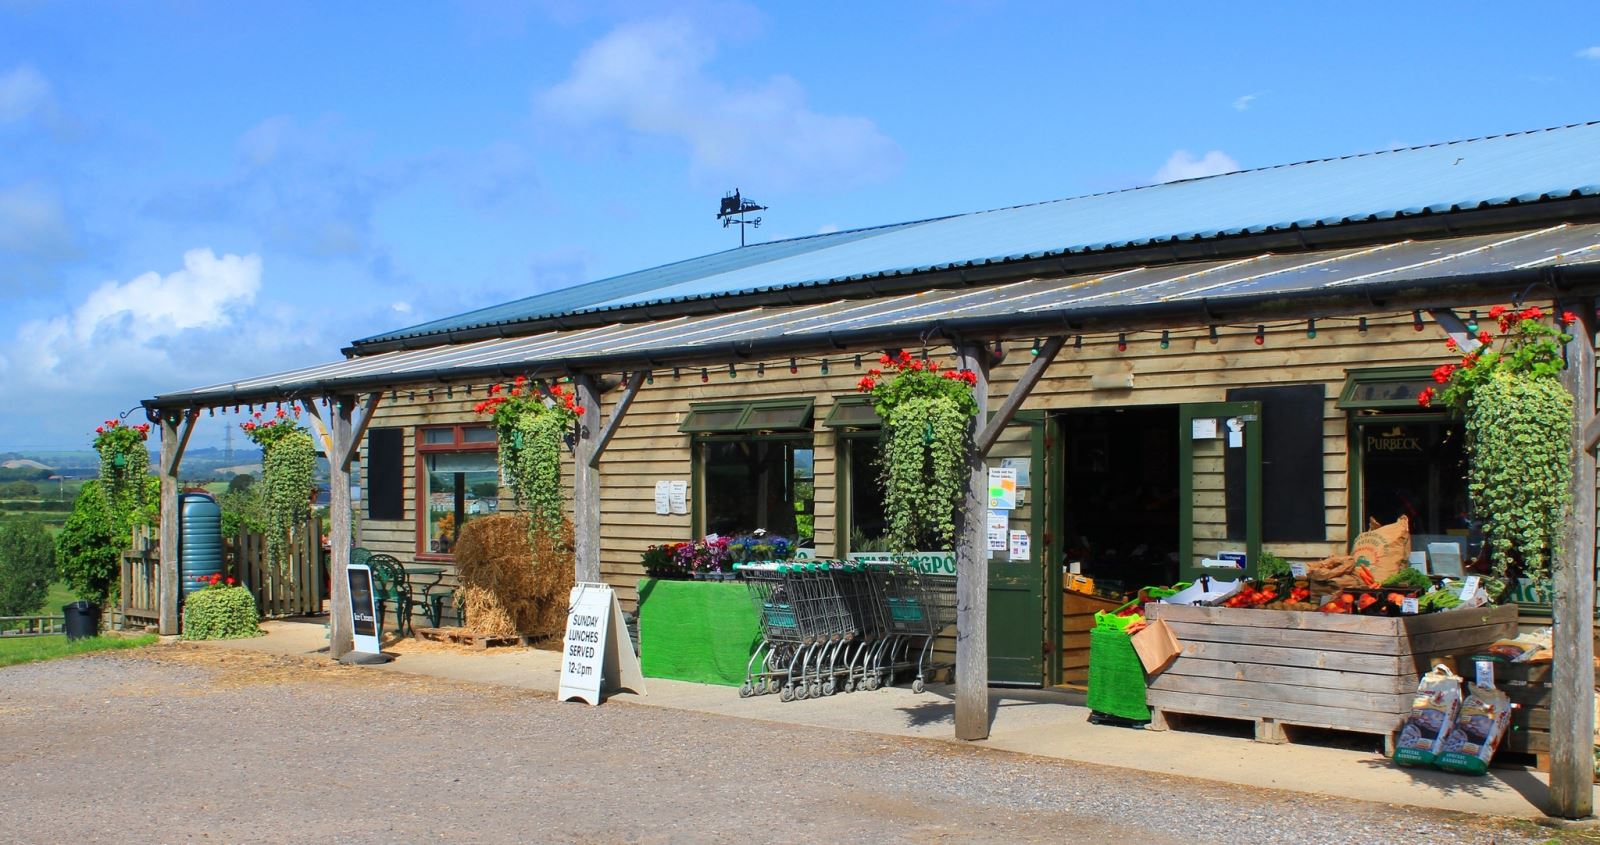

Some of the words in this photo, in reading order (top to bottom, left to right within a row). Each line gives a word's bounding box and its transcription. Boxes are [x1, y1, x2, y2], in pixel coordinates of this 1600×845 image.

[1367, 436, 1422, 452] PURBECK
[573, 614, 599, 628] SUNDAY
[568, 629, 599, 644] LUNCHES
[569, 644, 595, 659] SERVED
[568, 661, 593, 677] 12-2pm
